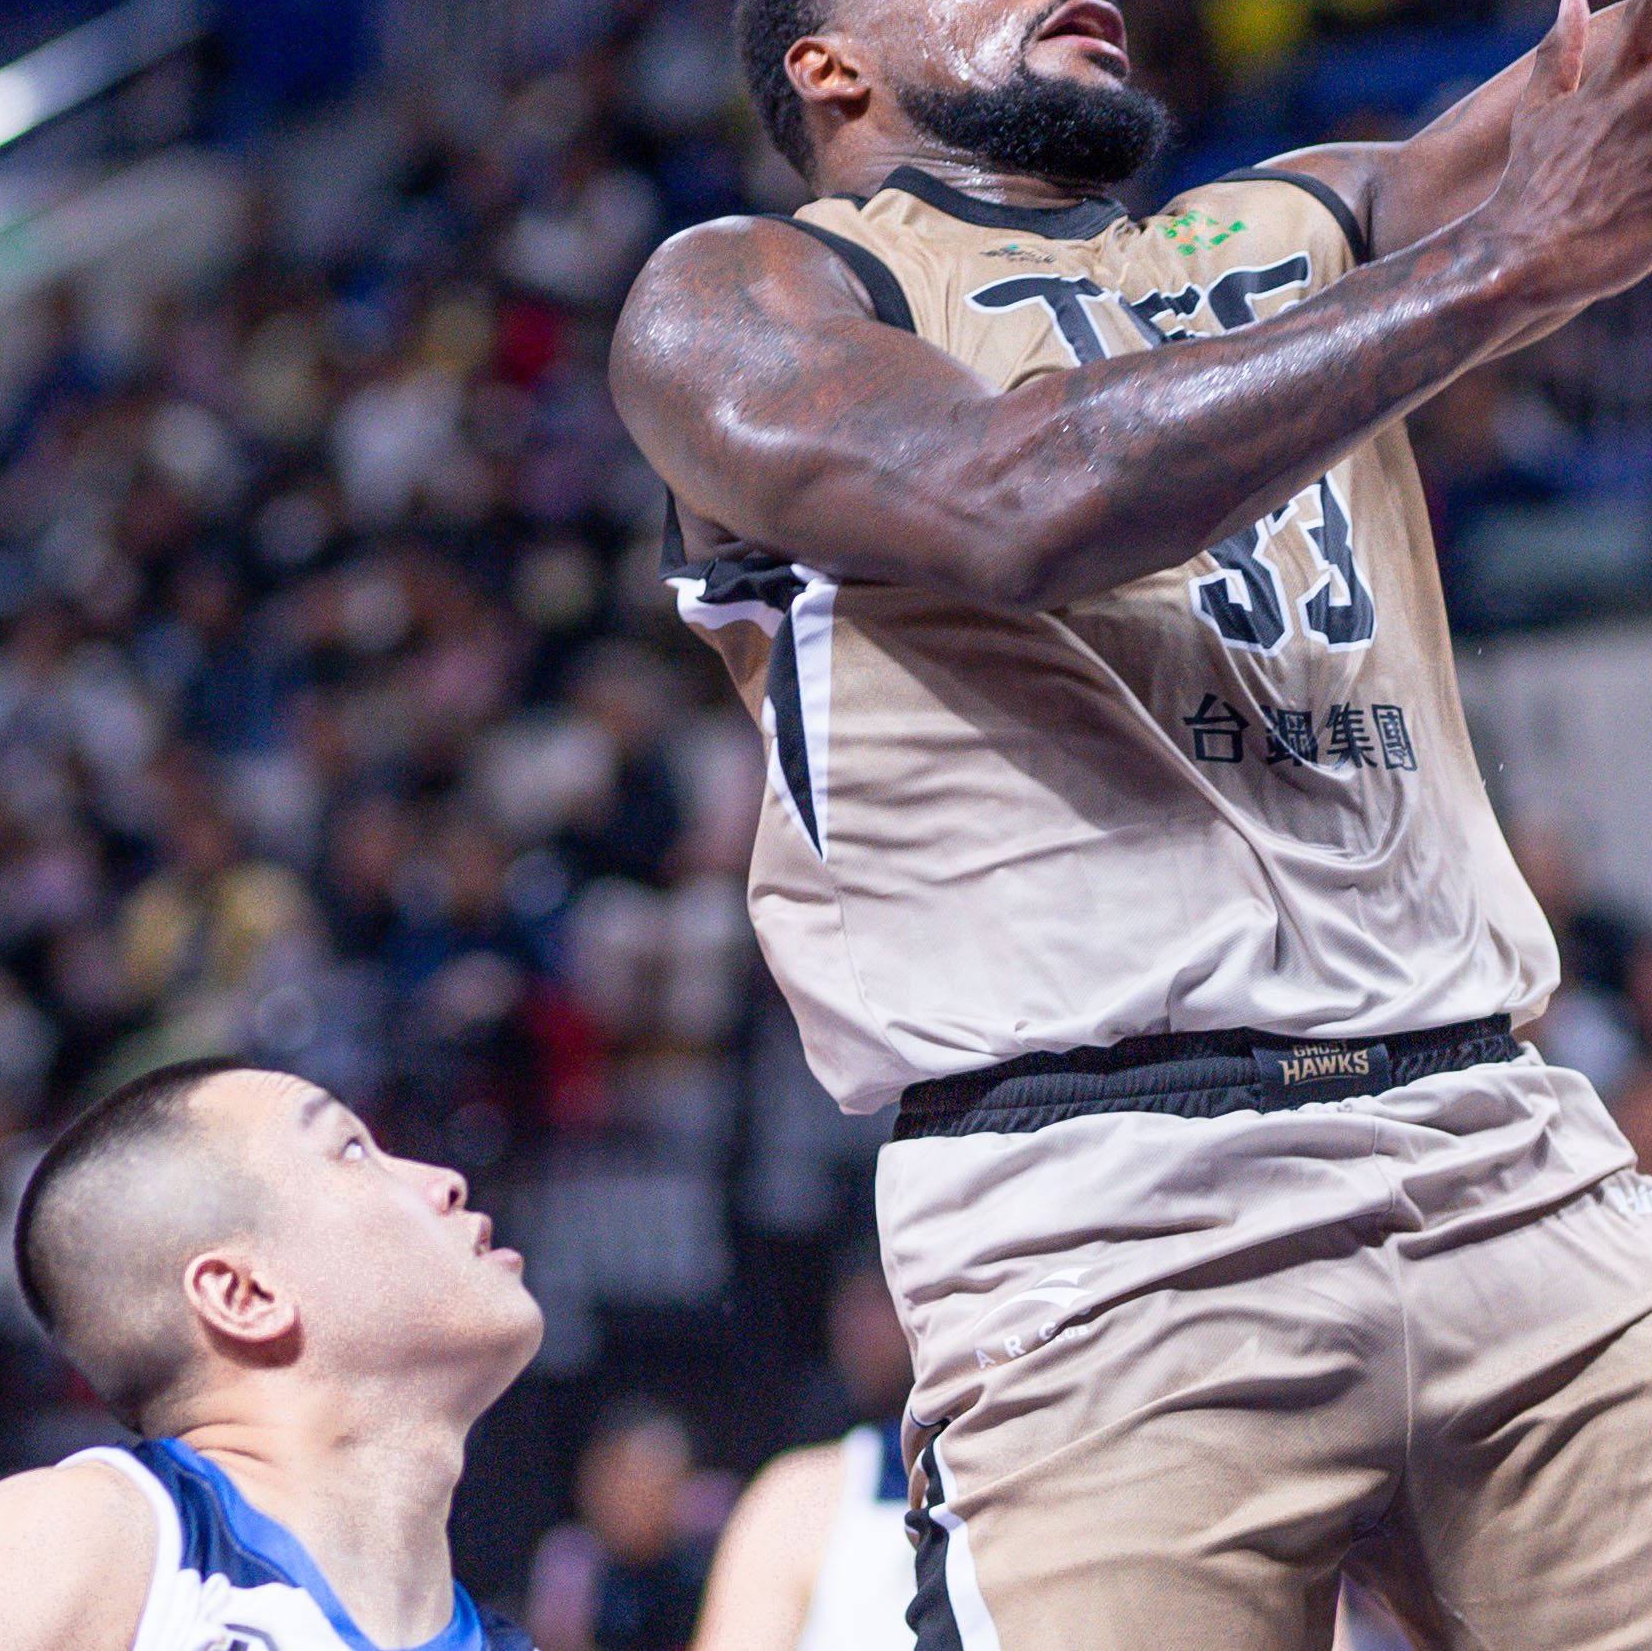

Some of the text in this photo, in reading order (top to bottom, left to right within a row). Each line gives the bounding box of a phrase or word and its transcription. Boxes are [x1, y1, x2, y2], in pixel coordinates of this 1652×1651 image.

[1183, 693, 1418, 772] 台鋼集團
[1278, 1049, 1369, 1086] HAWKS
